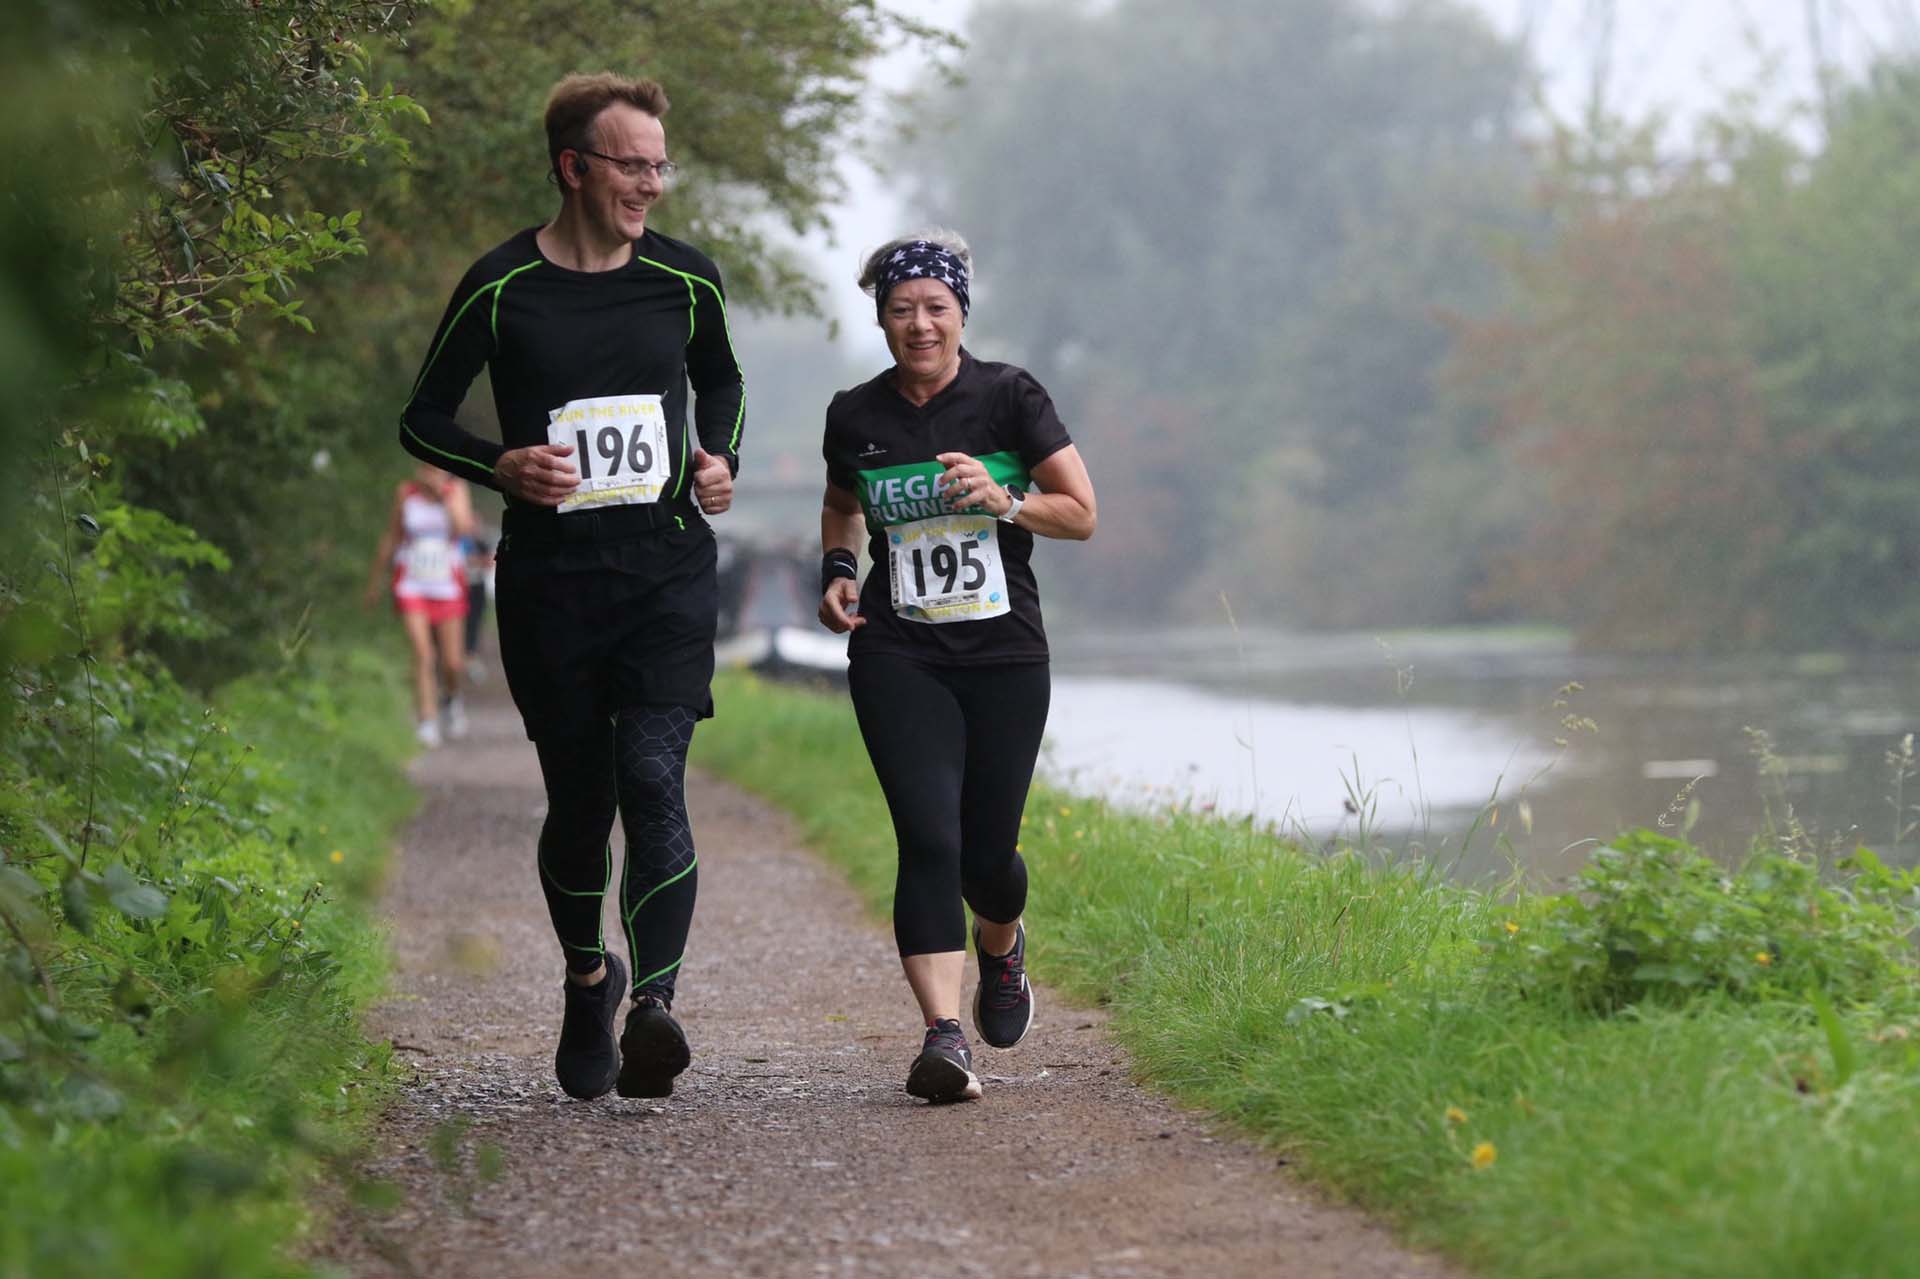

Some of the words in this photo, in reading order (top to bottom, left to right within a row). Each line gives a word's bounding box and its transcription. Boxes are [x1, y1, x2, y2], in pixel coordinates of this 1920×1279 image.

[576, 424, 653, 480] 196
[867, 472, 966, 505] VEGA
[912, 540, 986, 597] 195
